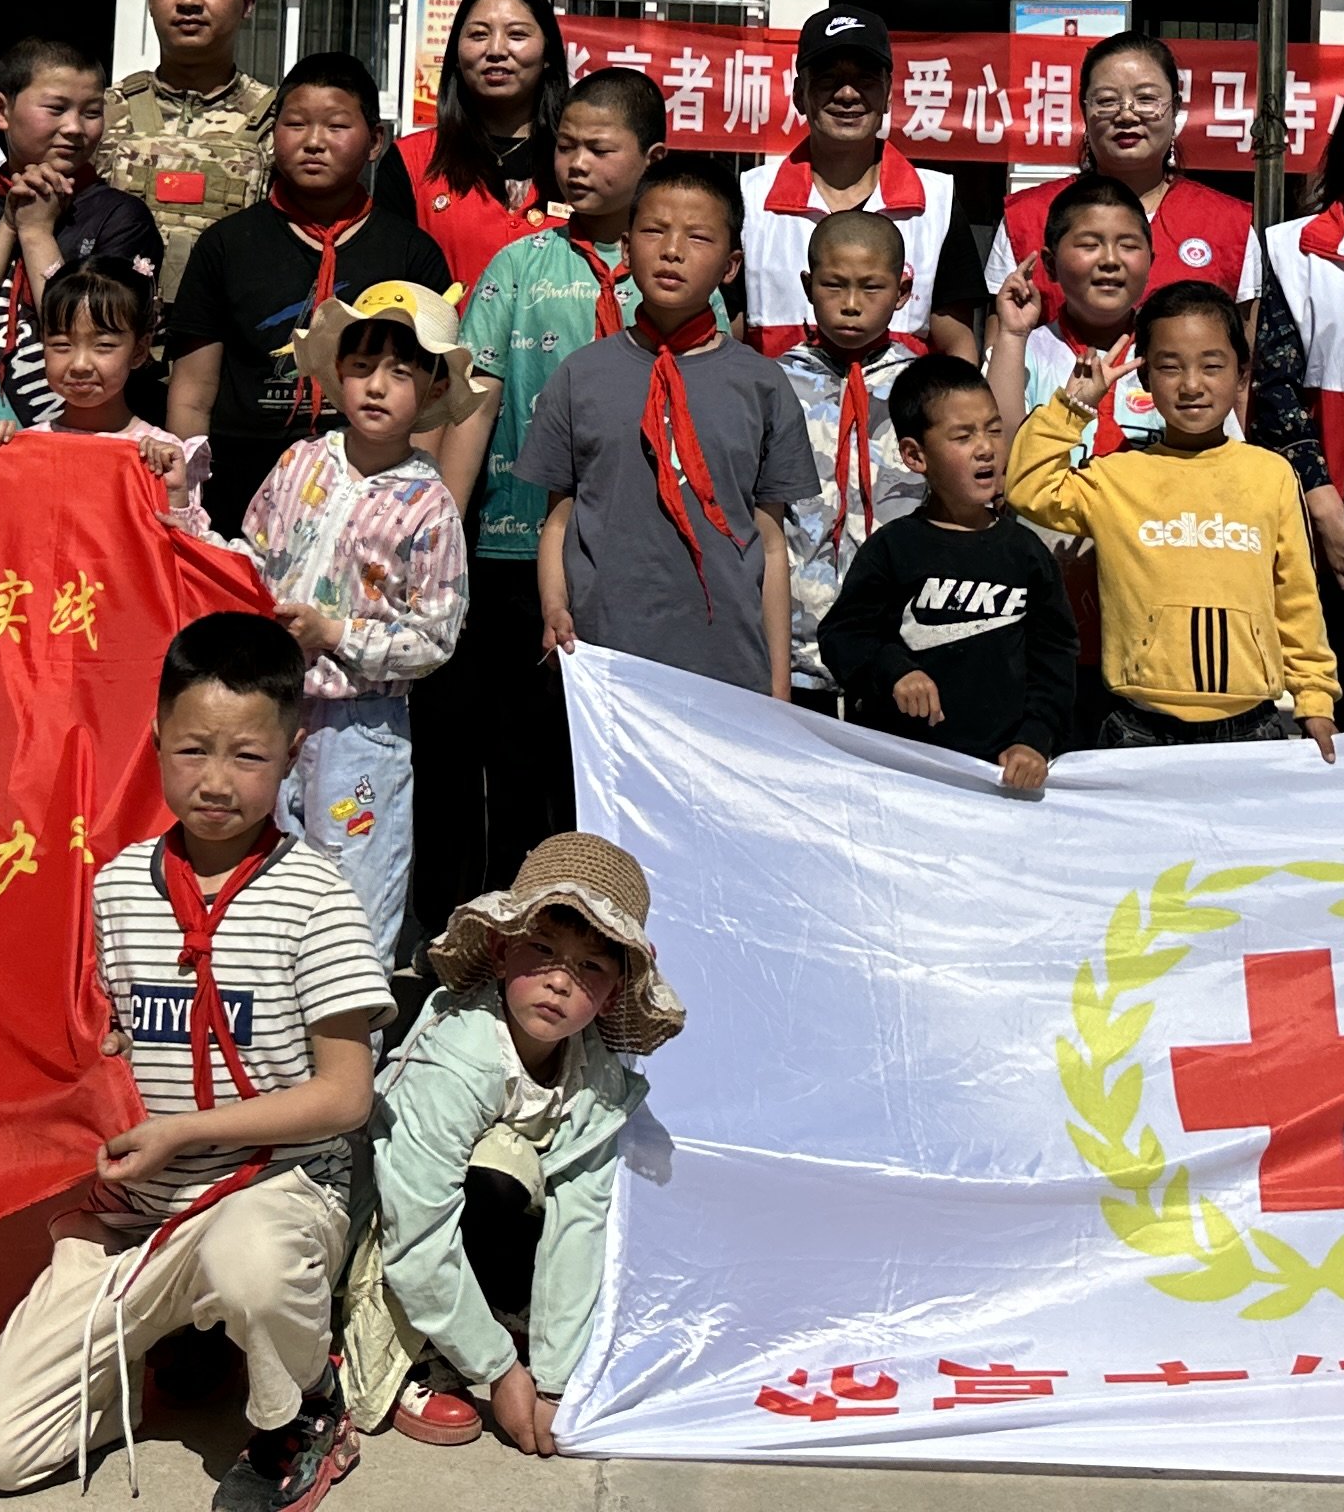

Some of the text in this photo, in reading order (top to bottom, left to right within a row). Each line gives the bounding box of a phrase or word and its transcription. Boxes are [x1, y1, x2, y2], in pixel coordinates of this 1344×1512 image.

[1138, 512, 1262, 554] adidas
[916, 577, 1027, 616] NIKE
[131, 994, 242, 1034] CITYY
